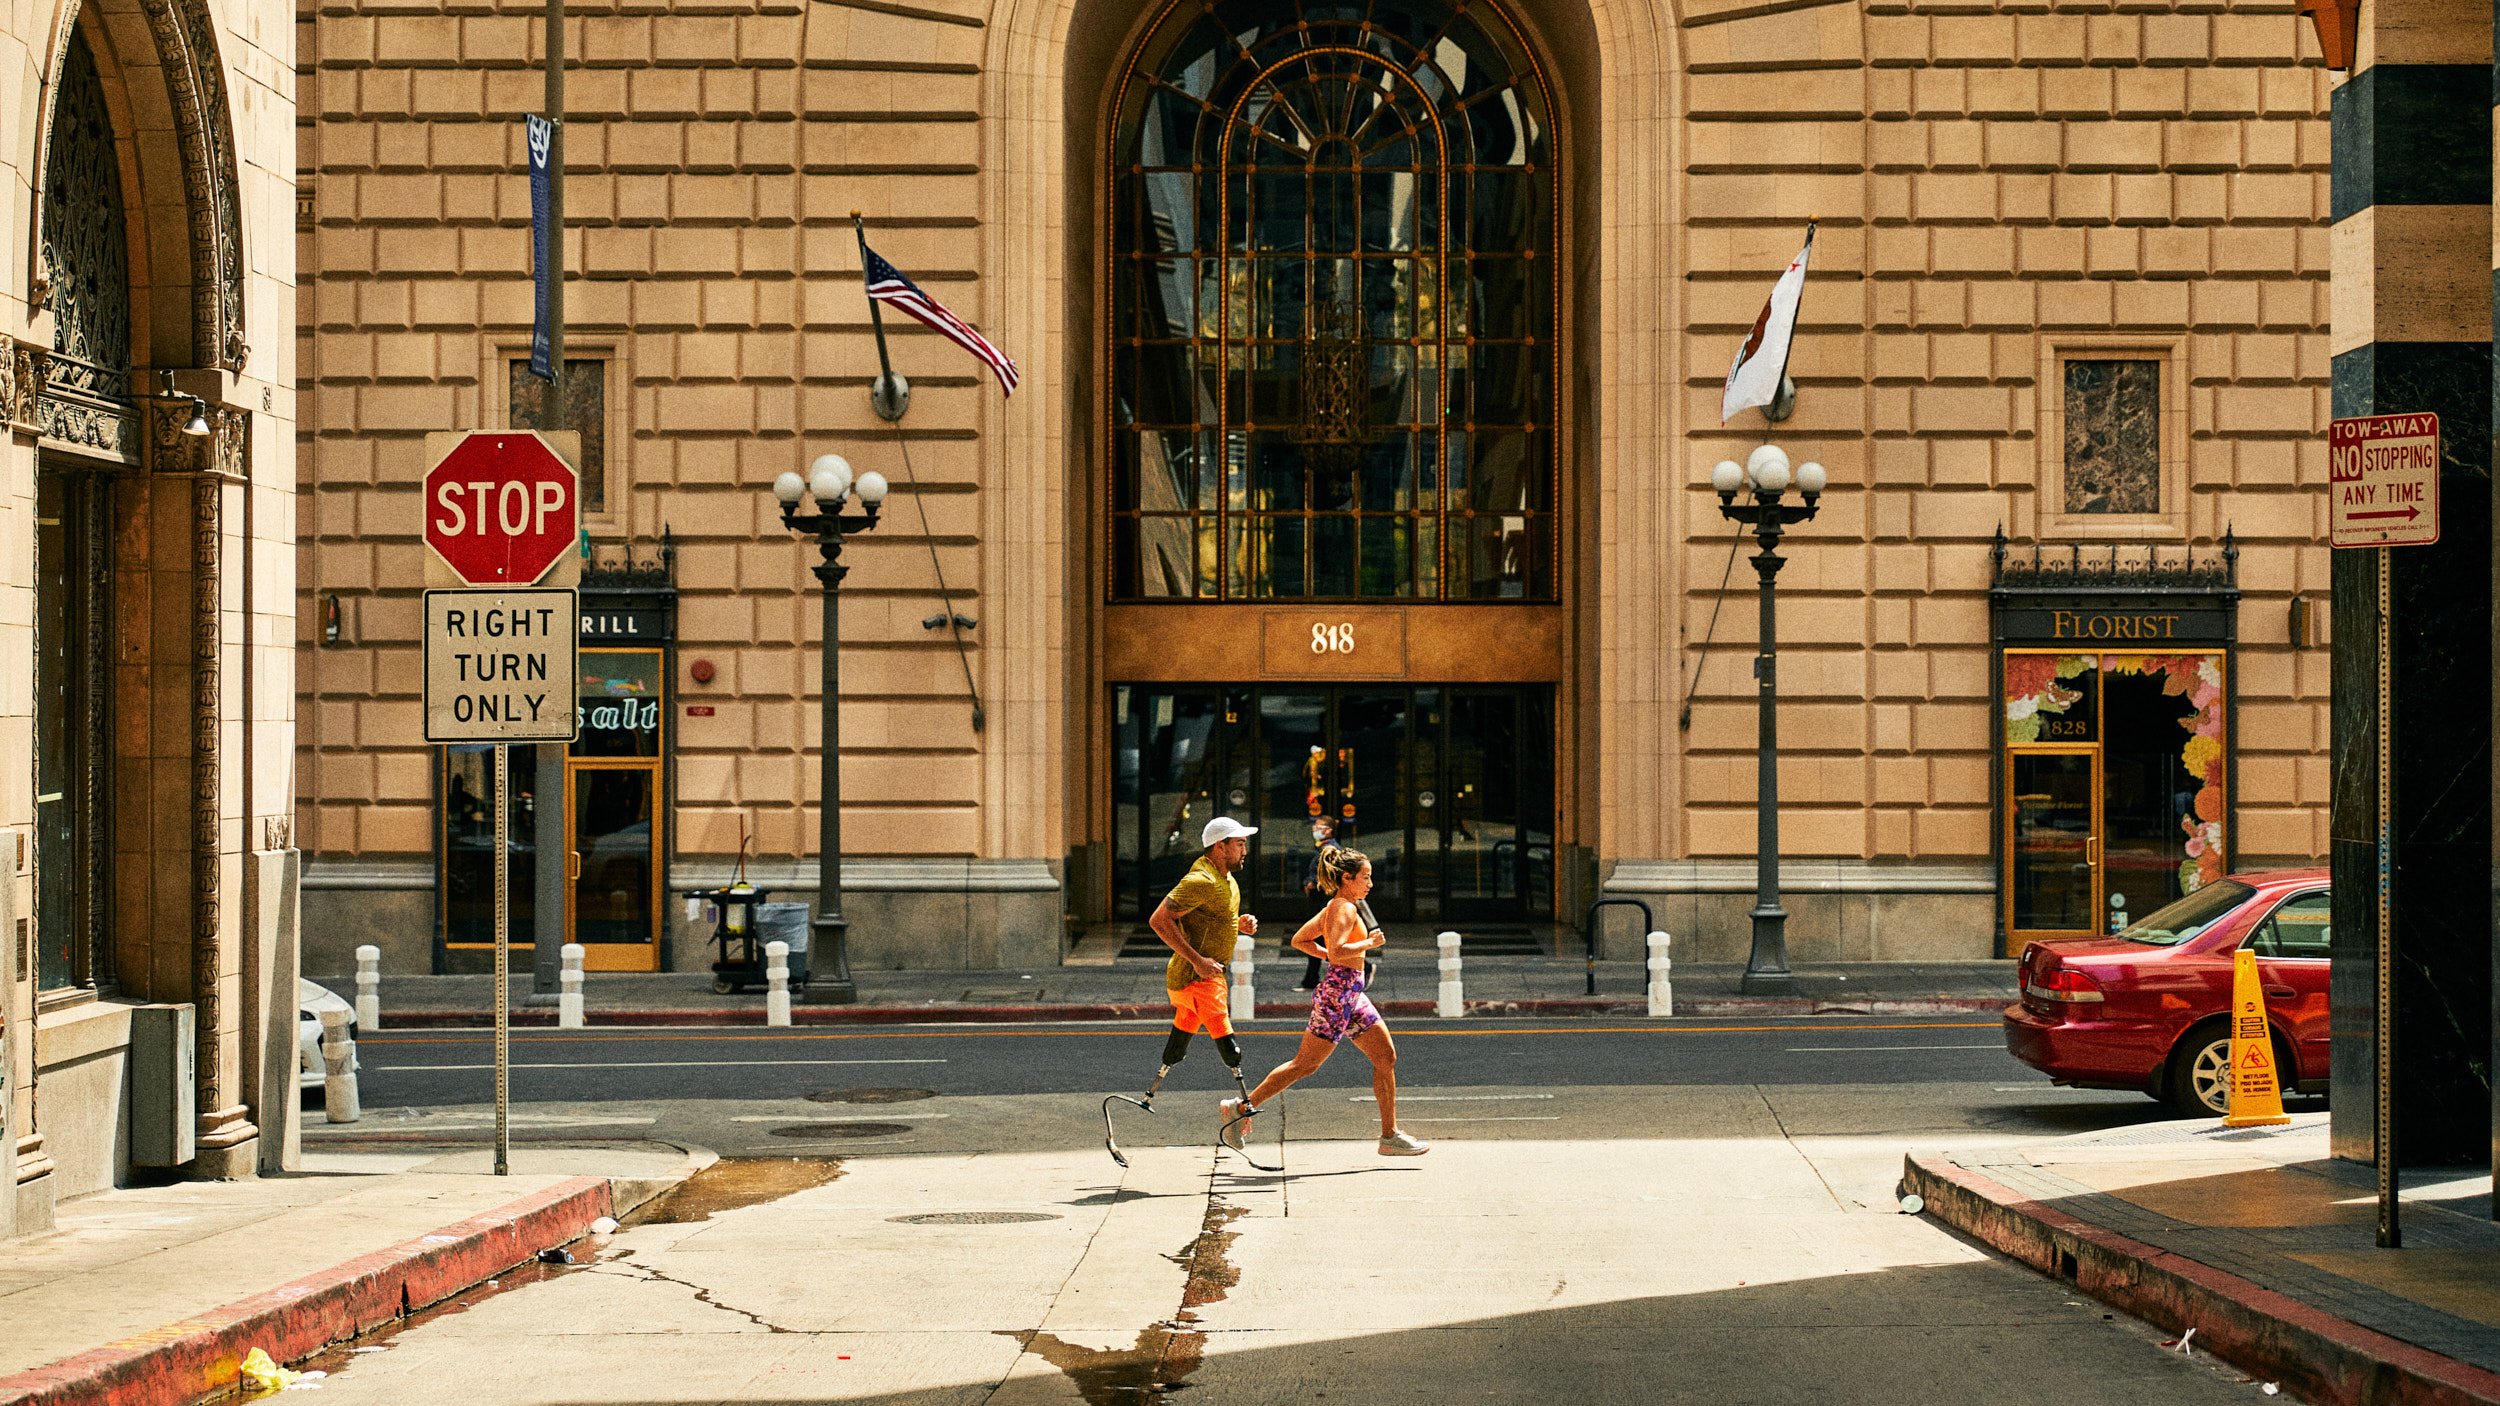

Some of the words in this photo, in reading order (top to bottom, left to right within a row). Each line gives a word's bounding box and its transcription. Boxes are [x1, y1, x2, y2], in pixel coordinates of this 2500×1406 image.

[2333, 417, 2433, 439] TOW-AWAY
[2332, 444, 2361, 478] NO
[2365, 444, 2432, 471] STOPPING
[2343, 484, 2376, 505] ANY
[2386, 482, 2424, 503] TIME
[435, 480, 566, 536] STOP
[447, 609, 553, 637] RIGHT
[2051, 611, 2179, 639] FLORIST
[1311, 622, 1355, 654] 818
[455, 654, 546, 681] TURN
[454, 694, 546, 722] ONLY
[2051, 720, 2086, 735] 828
